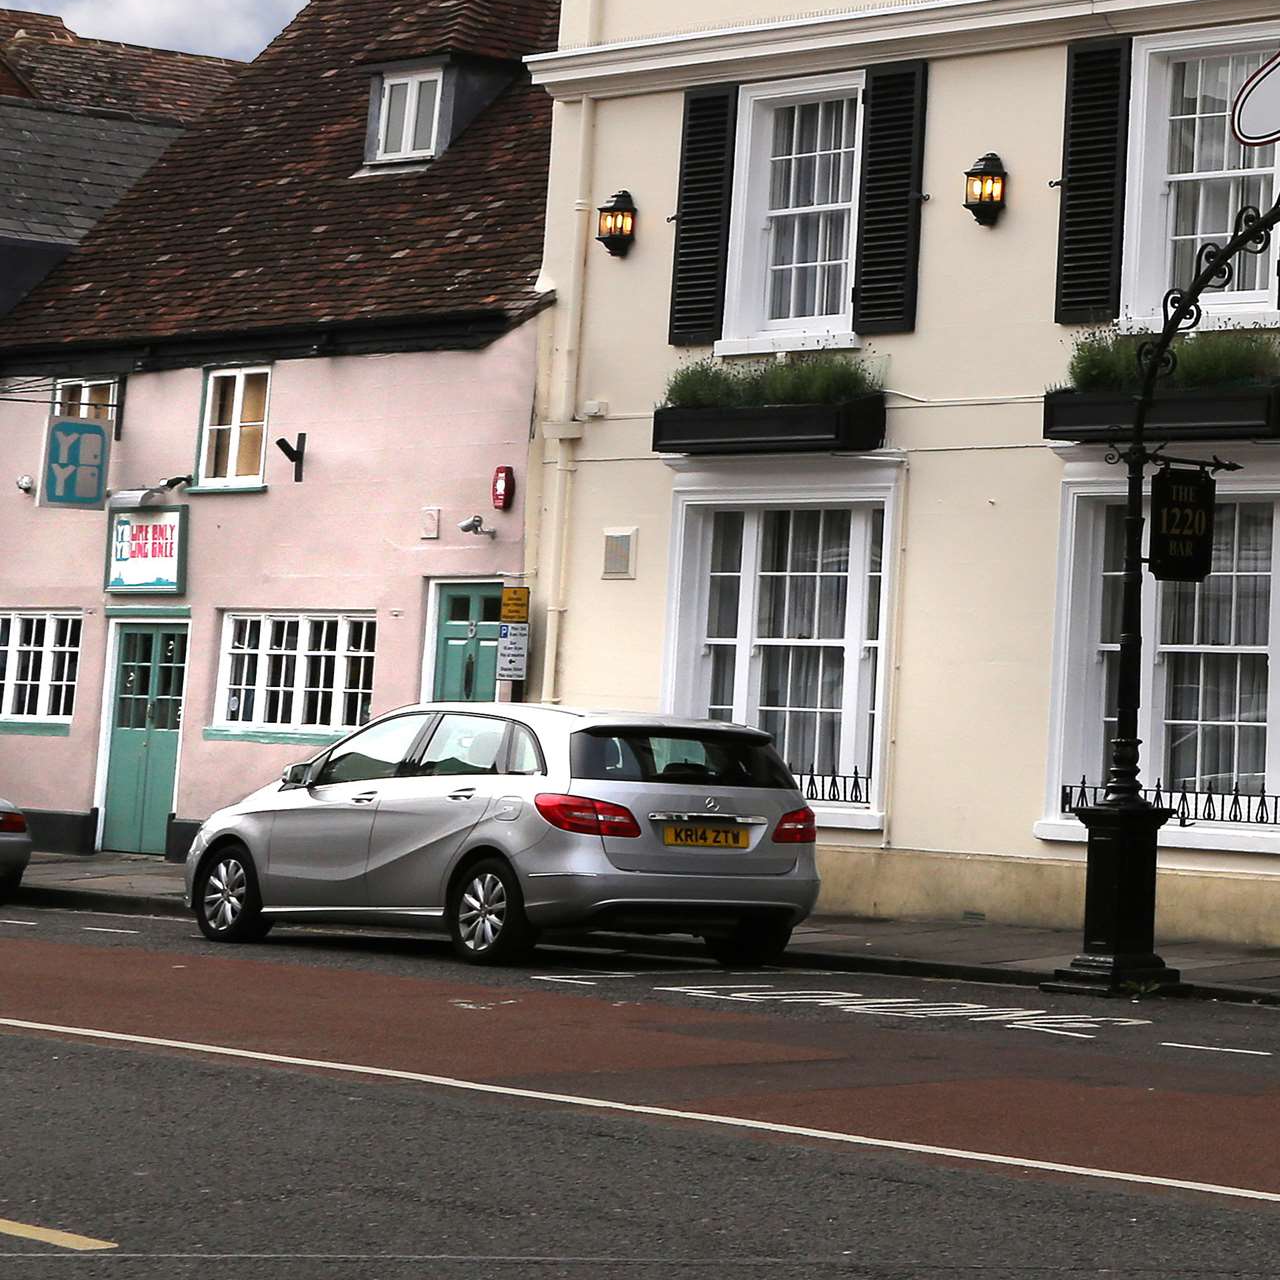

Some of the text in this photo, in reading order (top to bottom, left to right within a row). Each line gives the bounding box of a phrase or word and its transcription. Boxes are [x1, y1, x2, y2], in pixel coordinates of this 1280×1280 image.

[1169, 484, 1199, 503] THE
[1160, 507, 1207, 536] 1220
[1168, 541, 1194, 557] BAR
[674, 827, 740, 845] KR14 ZTW
[654, 983, 1154, 1032] LOADING
